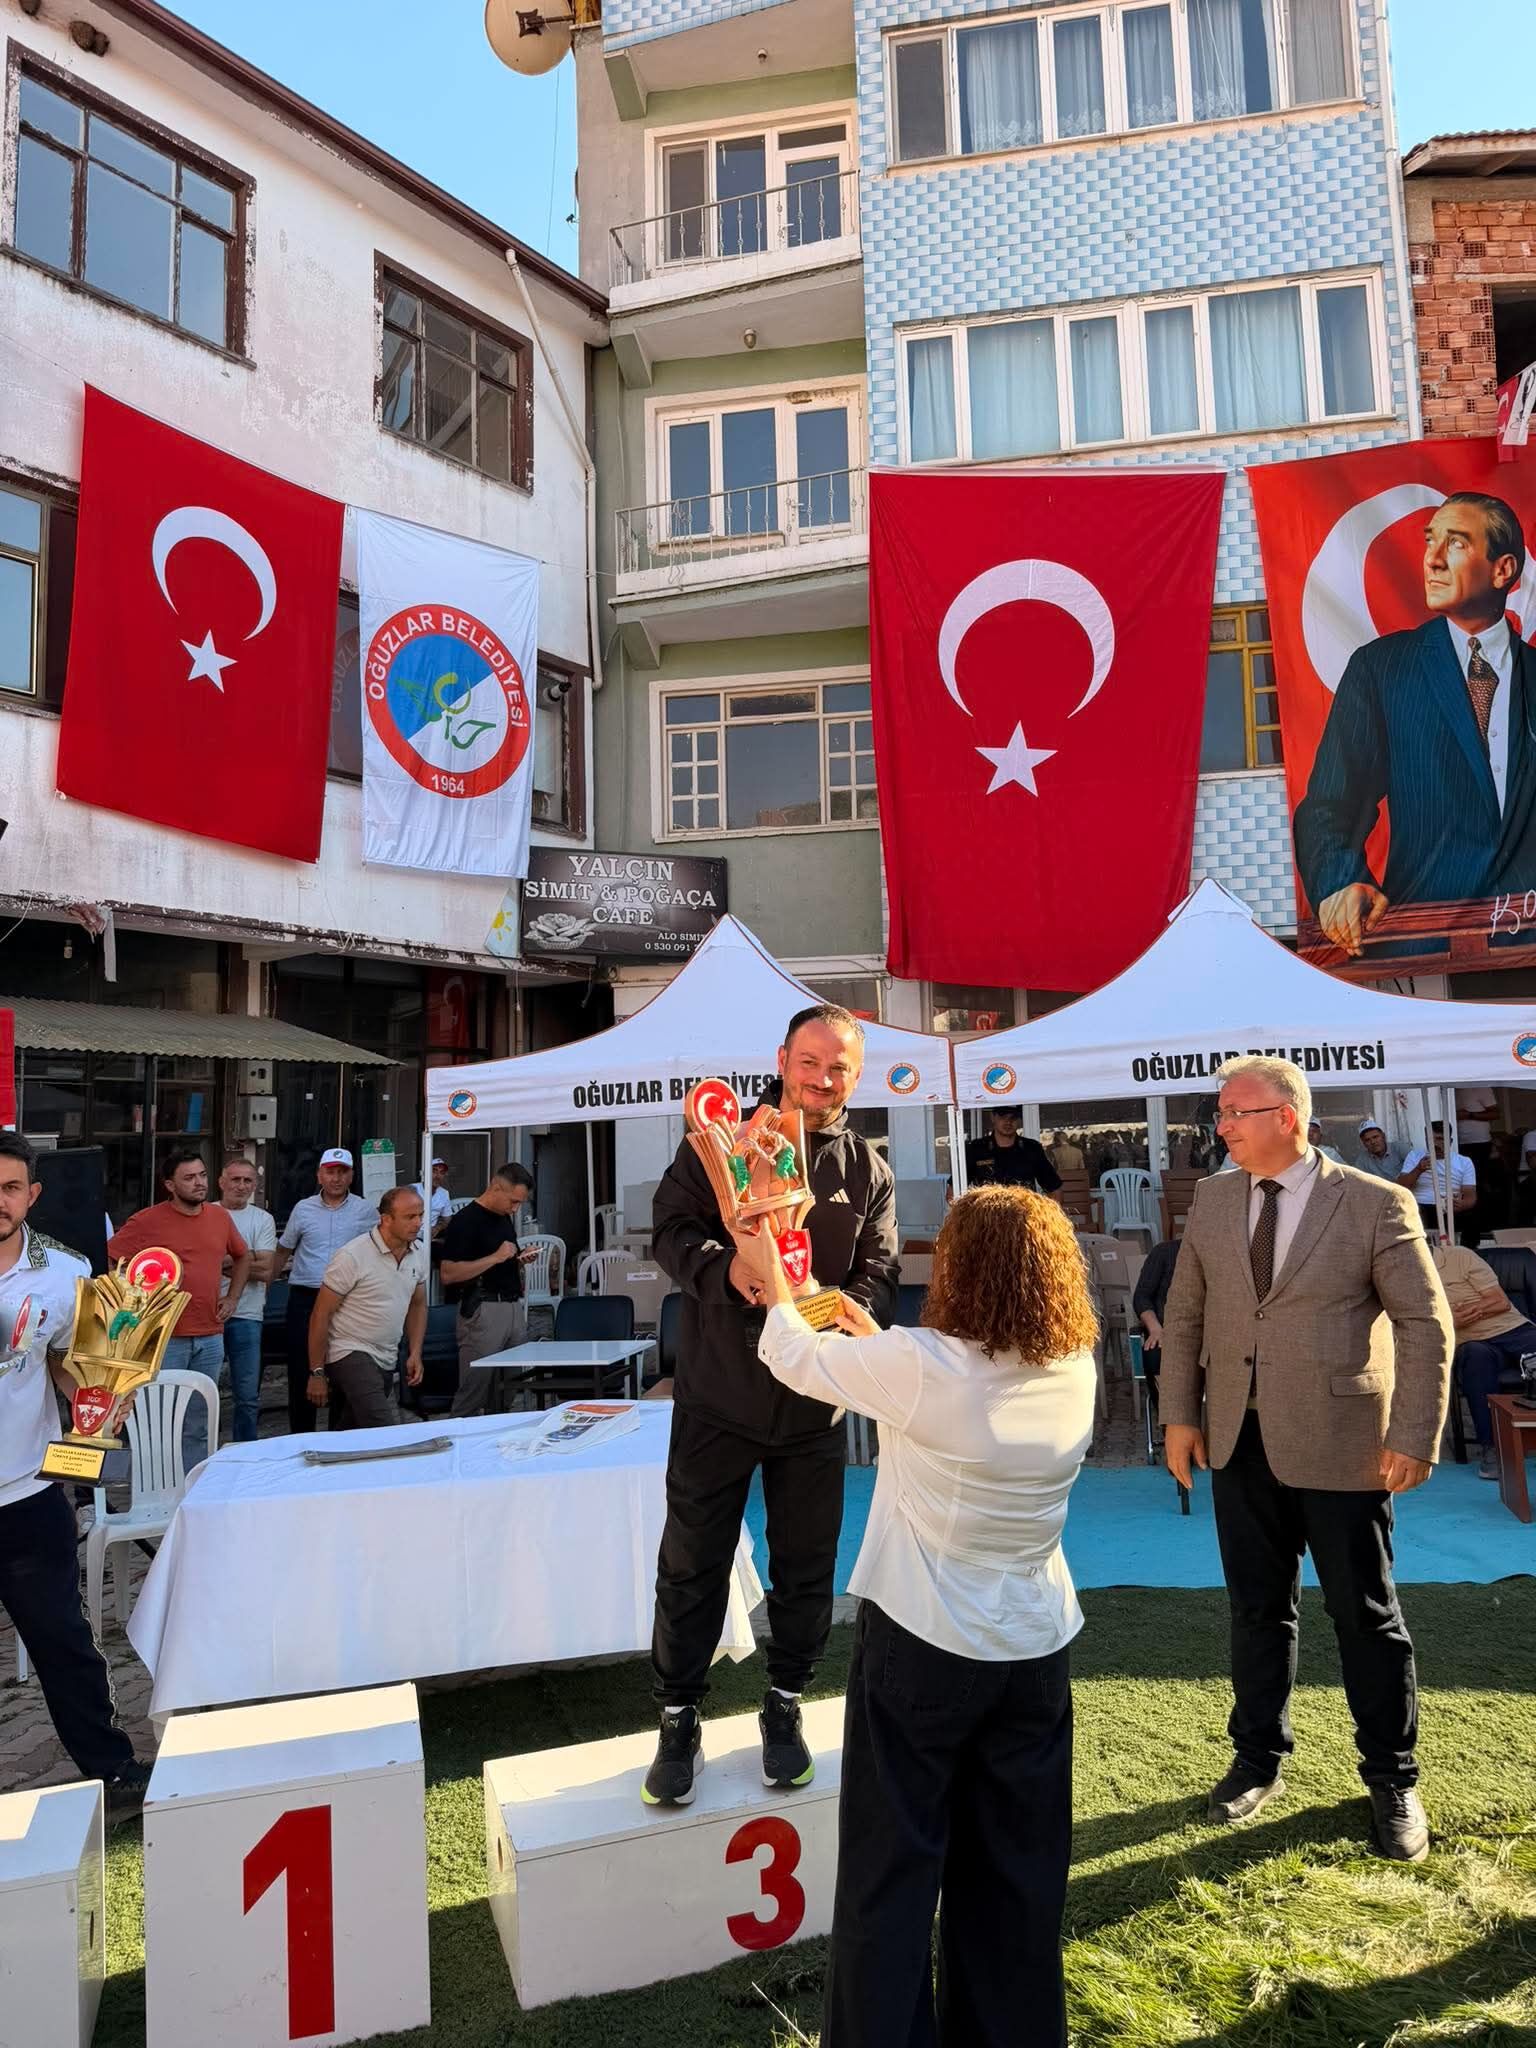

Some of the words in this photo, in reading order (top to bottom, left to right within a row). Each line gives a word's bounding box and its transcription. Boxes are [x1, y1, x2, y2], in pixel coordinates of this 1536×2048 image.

[367, 612, 435, 700] OĞUZLAR
[442, 613, 527, 728] BELEDİYESİ
[432, 774, 465, 795] 1964
[568, 855, 674, 884] YALÇIN
[525, 877, 593, 900] SİMİT
[600, 885, 617, 901] &
[624, 883, 717, 910] POĞAÇA
[592, 906, 653, 925] CAFE
[645, 942, 651, 950] 0
[654, 943, 671, 951] 530
[674, 944, 691, 952] 091
[657, 932, 677, 940] ALO
[1132, 1051, 1240, 1082] OĞUZLA
[1247, 1040, 1384, 1071] EDİYESİ
[573, 1080, 663, 1108] OĞUZLAR
[724, 1816, 807, 1952] 3
[243, 1804, 336, 2041] 1
